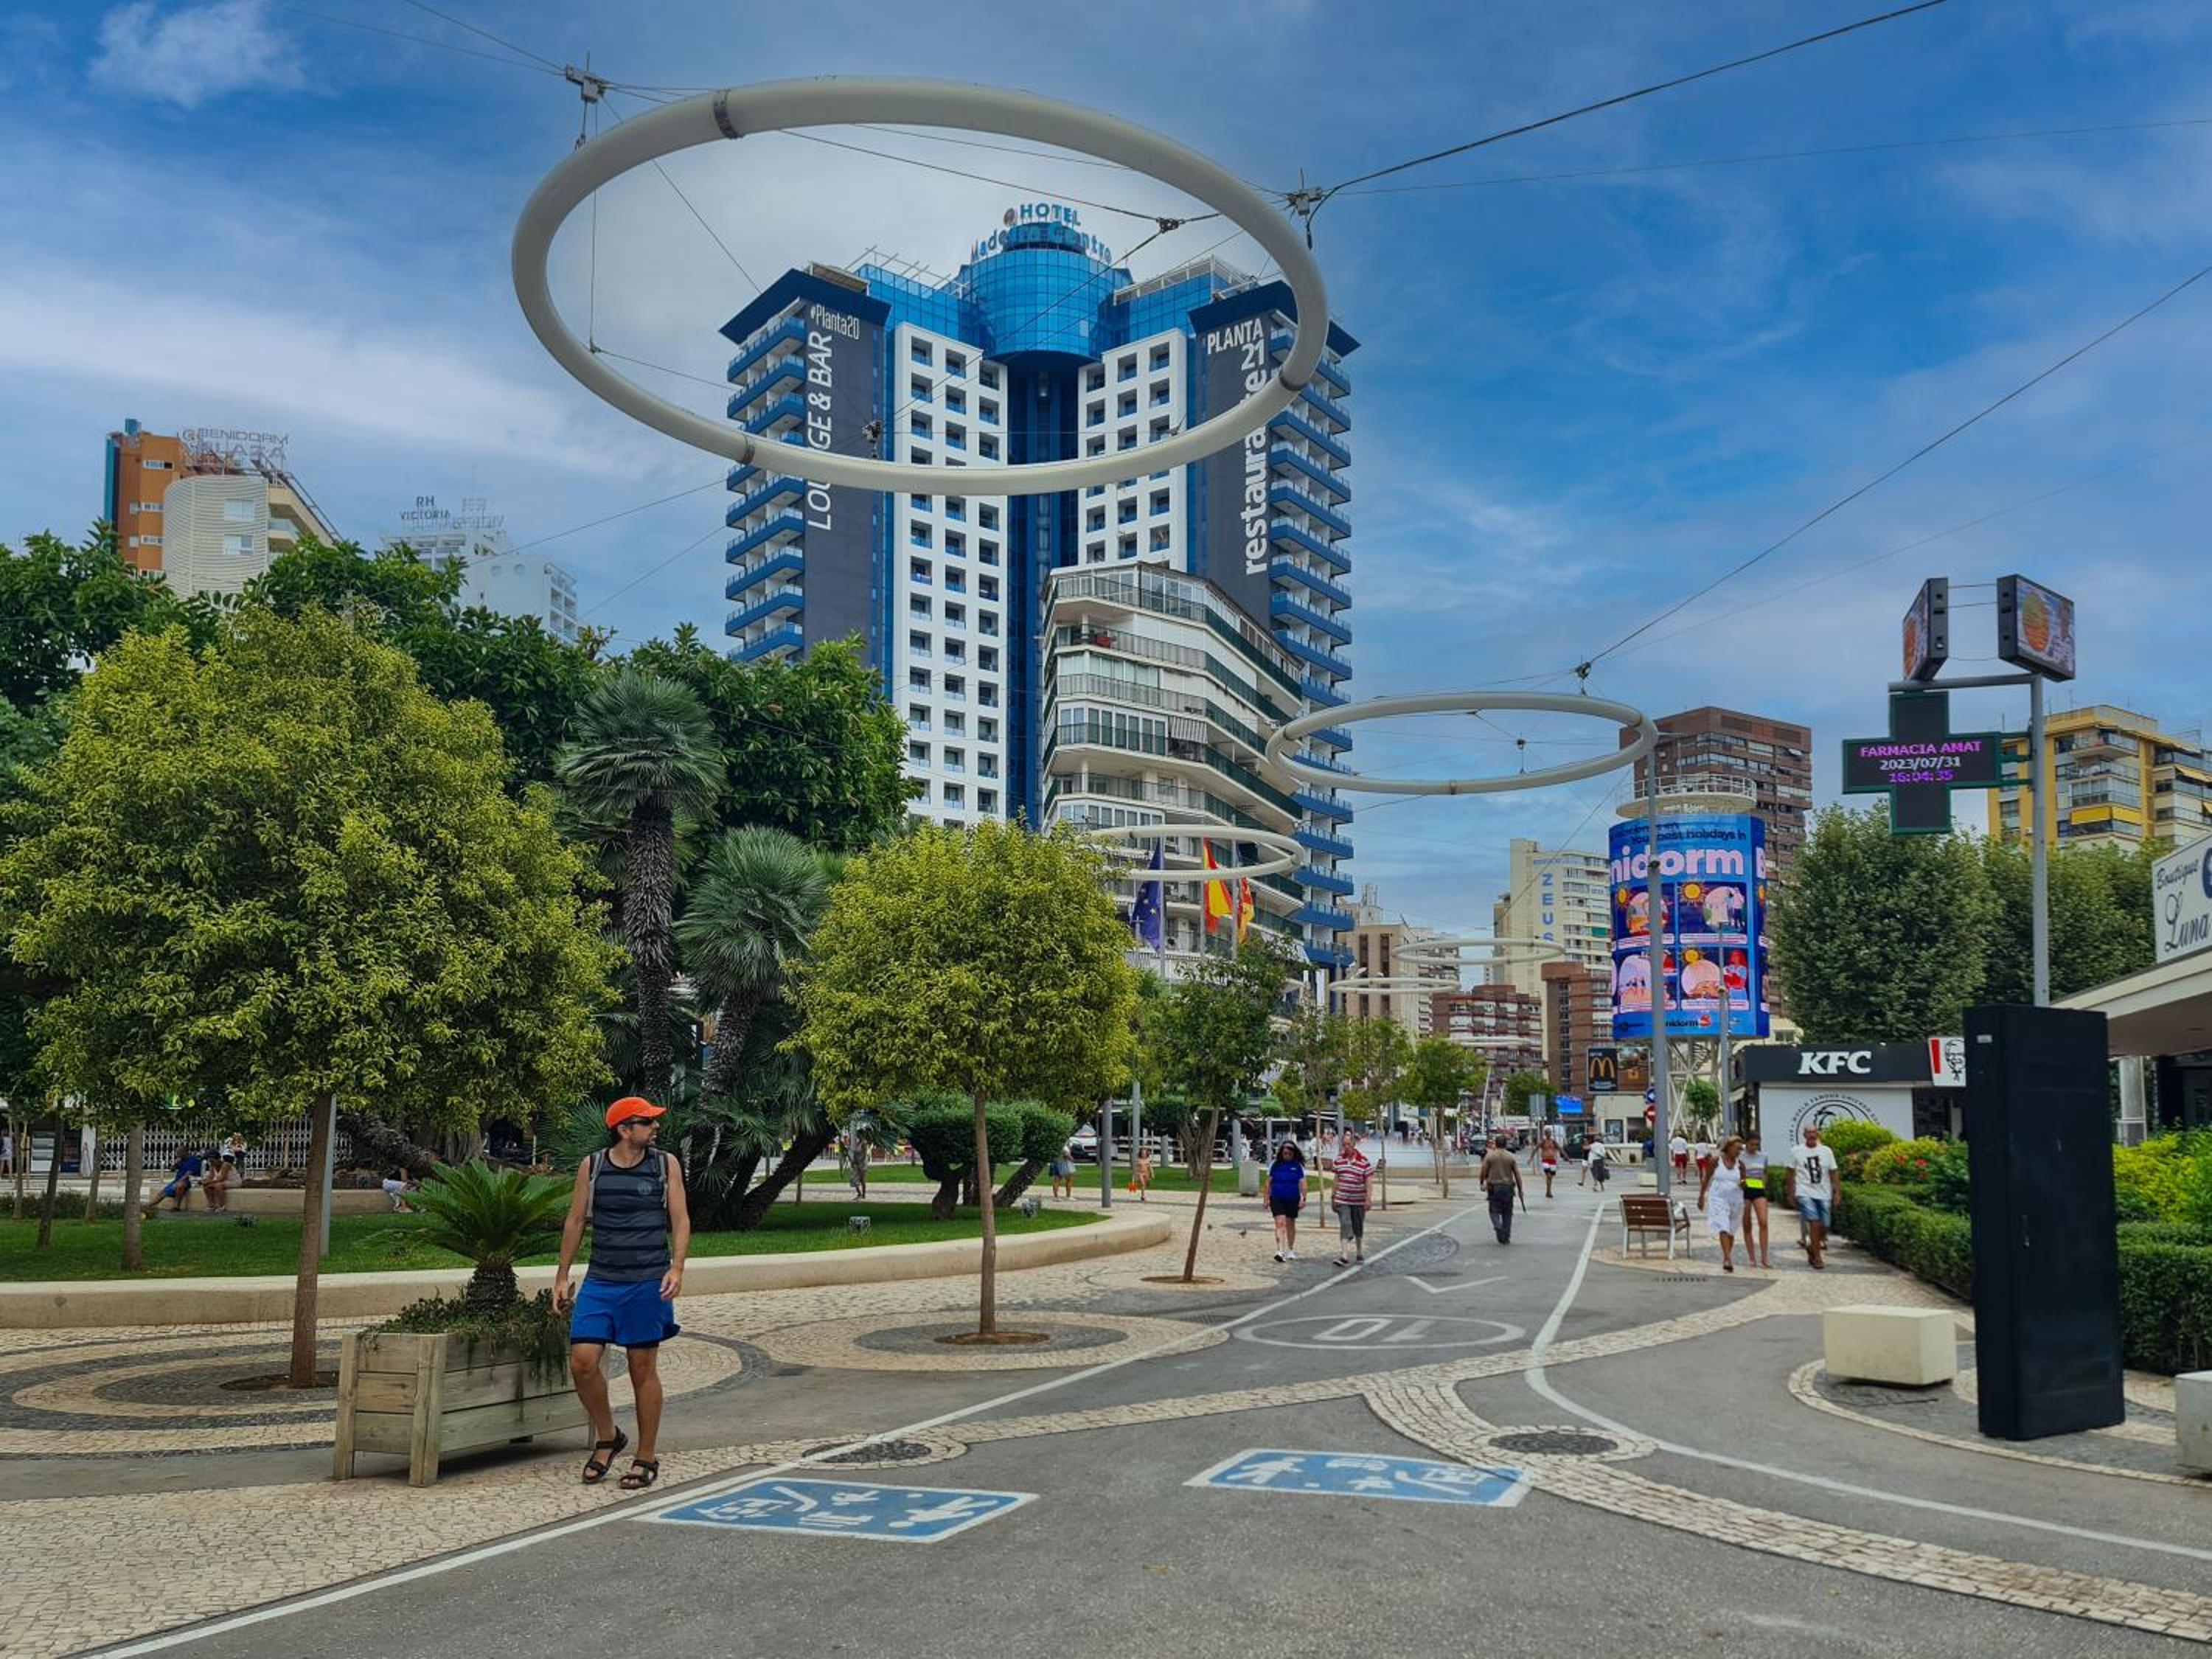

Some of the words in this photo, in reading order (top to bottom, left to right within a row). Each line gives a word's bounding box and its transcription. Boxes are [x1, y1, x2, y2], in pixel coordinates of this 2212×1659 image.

[1020, 203, 1081, 226] HOTEL
[1207, 318, 1263, 355] PLANTA
[808, 331, 832, 387] BAR
[1241, 338, 1265, 371] 21
[807, 411, 832, 530] LOGE
[1240, 369, 1267, 575] restaurae
[417, 495, 435, 507] RH
[1860, 742, 1937, 757] FARMACIA
[1940, 740, 1982, 753] AMAT
[1879, 756, 1961, 771] 2023/07/31
[1541, 872, 1554, 942] ZEUS
[1798, 1050, 1872, 1074] KFC
